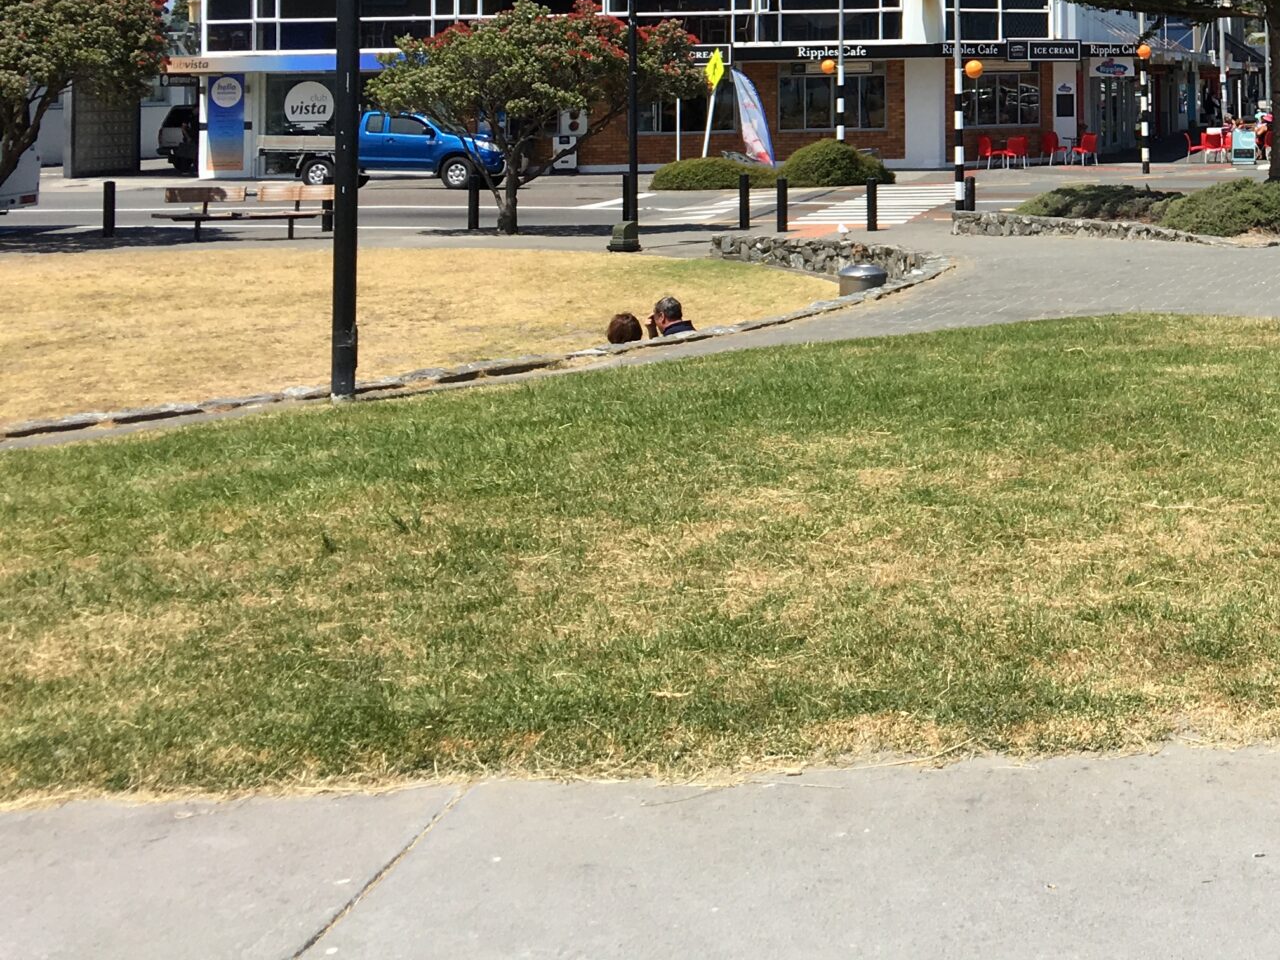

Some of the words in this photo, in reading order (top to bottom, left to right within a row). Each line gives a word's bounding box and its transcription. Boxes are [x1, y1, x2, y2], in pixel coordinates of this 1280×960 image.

[797, 45, 839, 60] Ripples
[842, 45, 867, 56] Cafe
[977, 43, 998, 55] Cafe
[1090, 43, 1120, 57] Ripples
[217, 83, 237, 91] hello
[310, 93, 328, 102] club
[290, 101, 327, 115] vista
